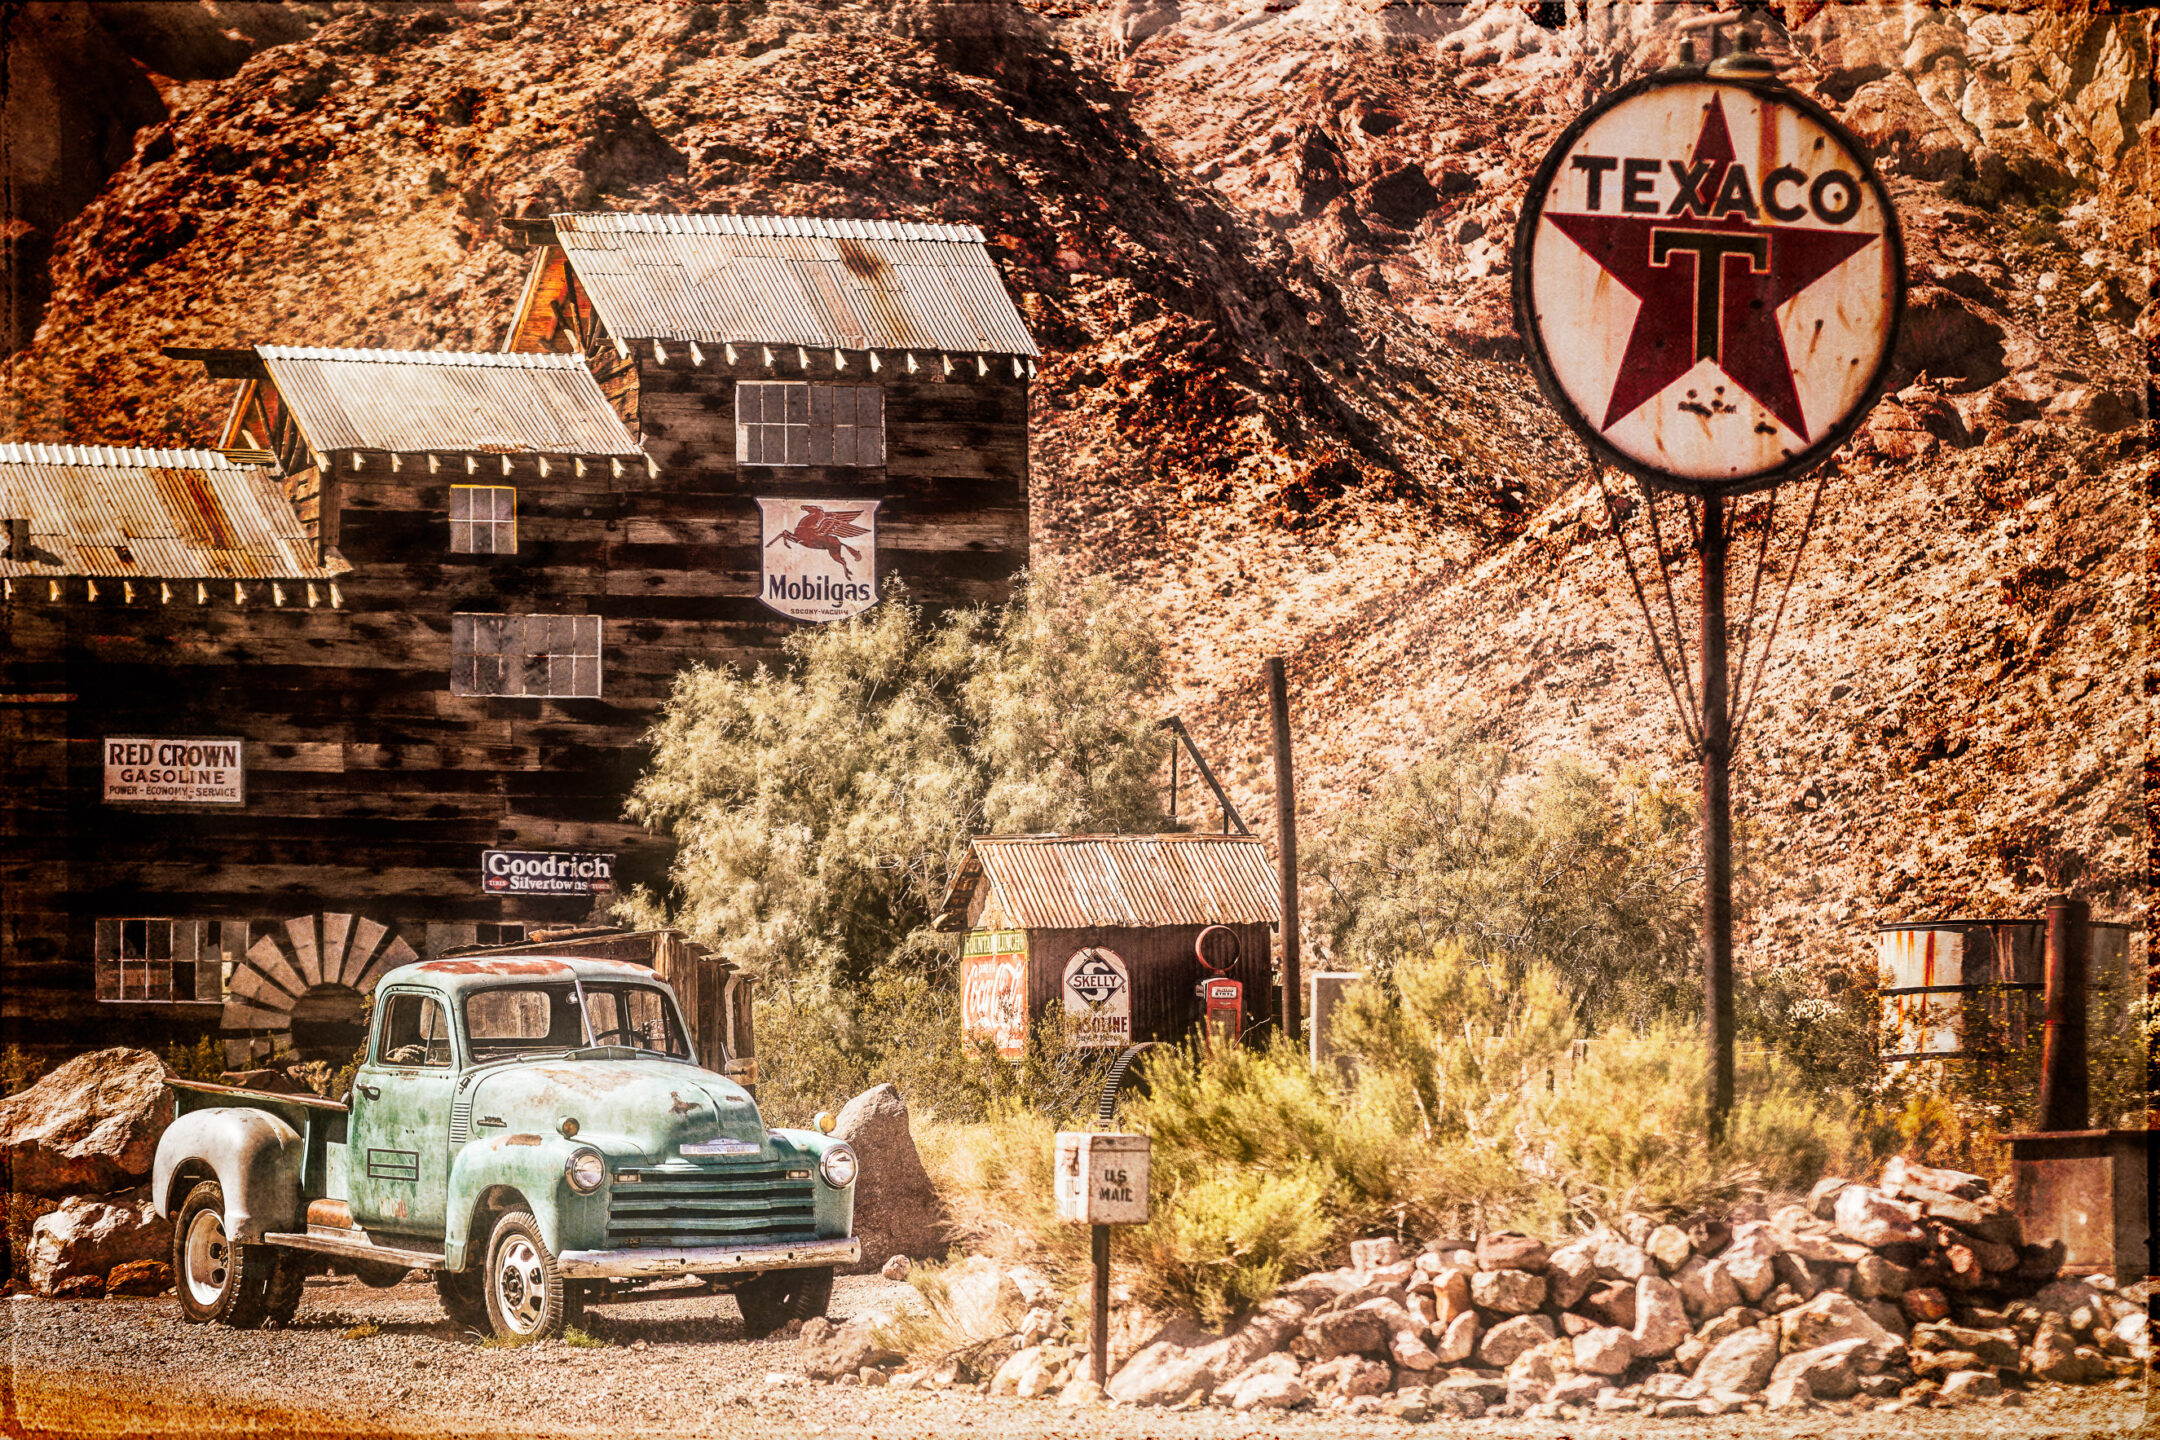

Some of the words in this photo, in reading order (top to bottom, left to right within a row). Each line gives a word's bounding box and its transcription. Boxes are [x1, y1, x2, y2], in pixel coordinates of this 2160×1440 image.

[1572, 155, 1862, 224] TEXACO
[1649, 227, 1772, 364] T
[769, 574, 870, 608] Mobilgas
[109, 743, 154, 766] RED
[159, 744, 236, 767] CROWN
[121, 769, 225, 784] GASOLINE
[109, 786, 137, 795] POWER
[195, 788, 236, 797] SERVICE
[488, 853, 611, 878] Goodrich
[510, 875, 588, 890] Silvertowns
[1073, 976, 1117, 987] SKELLY
[1099, 1187, 1133, 1202] MAIL
